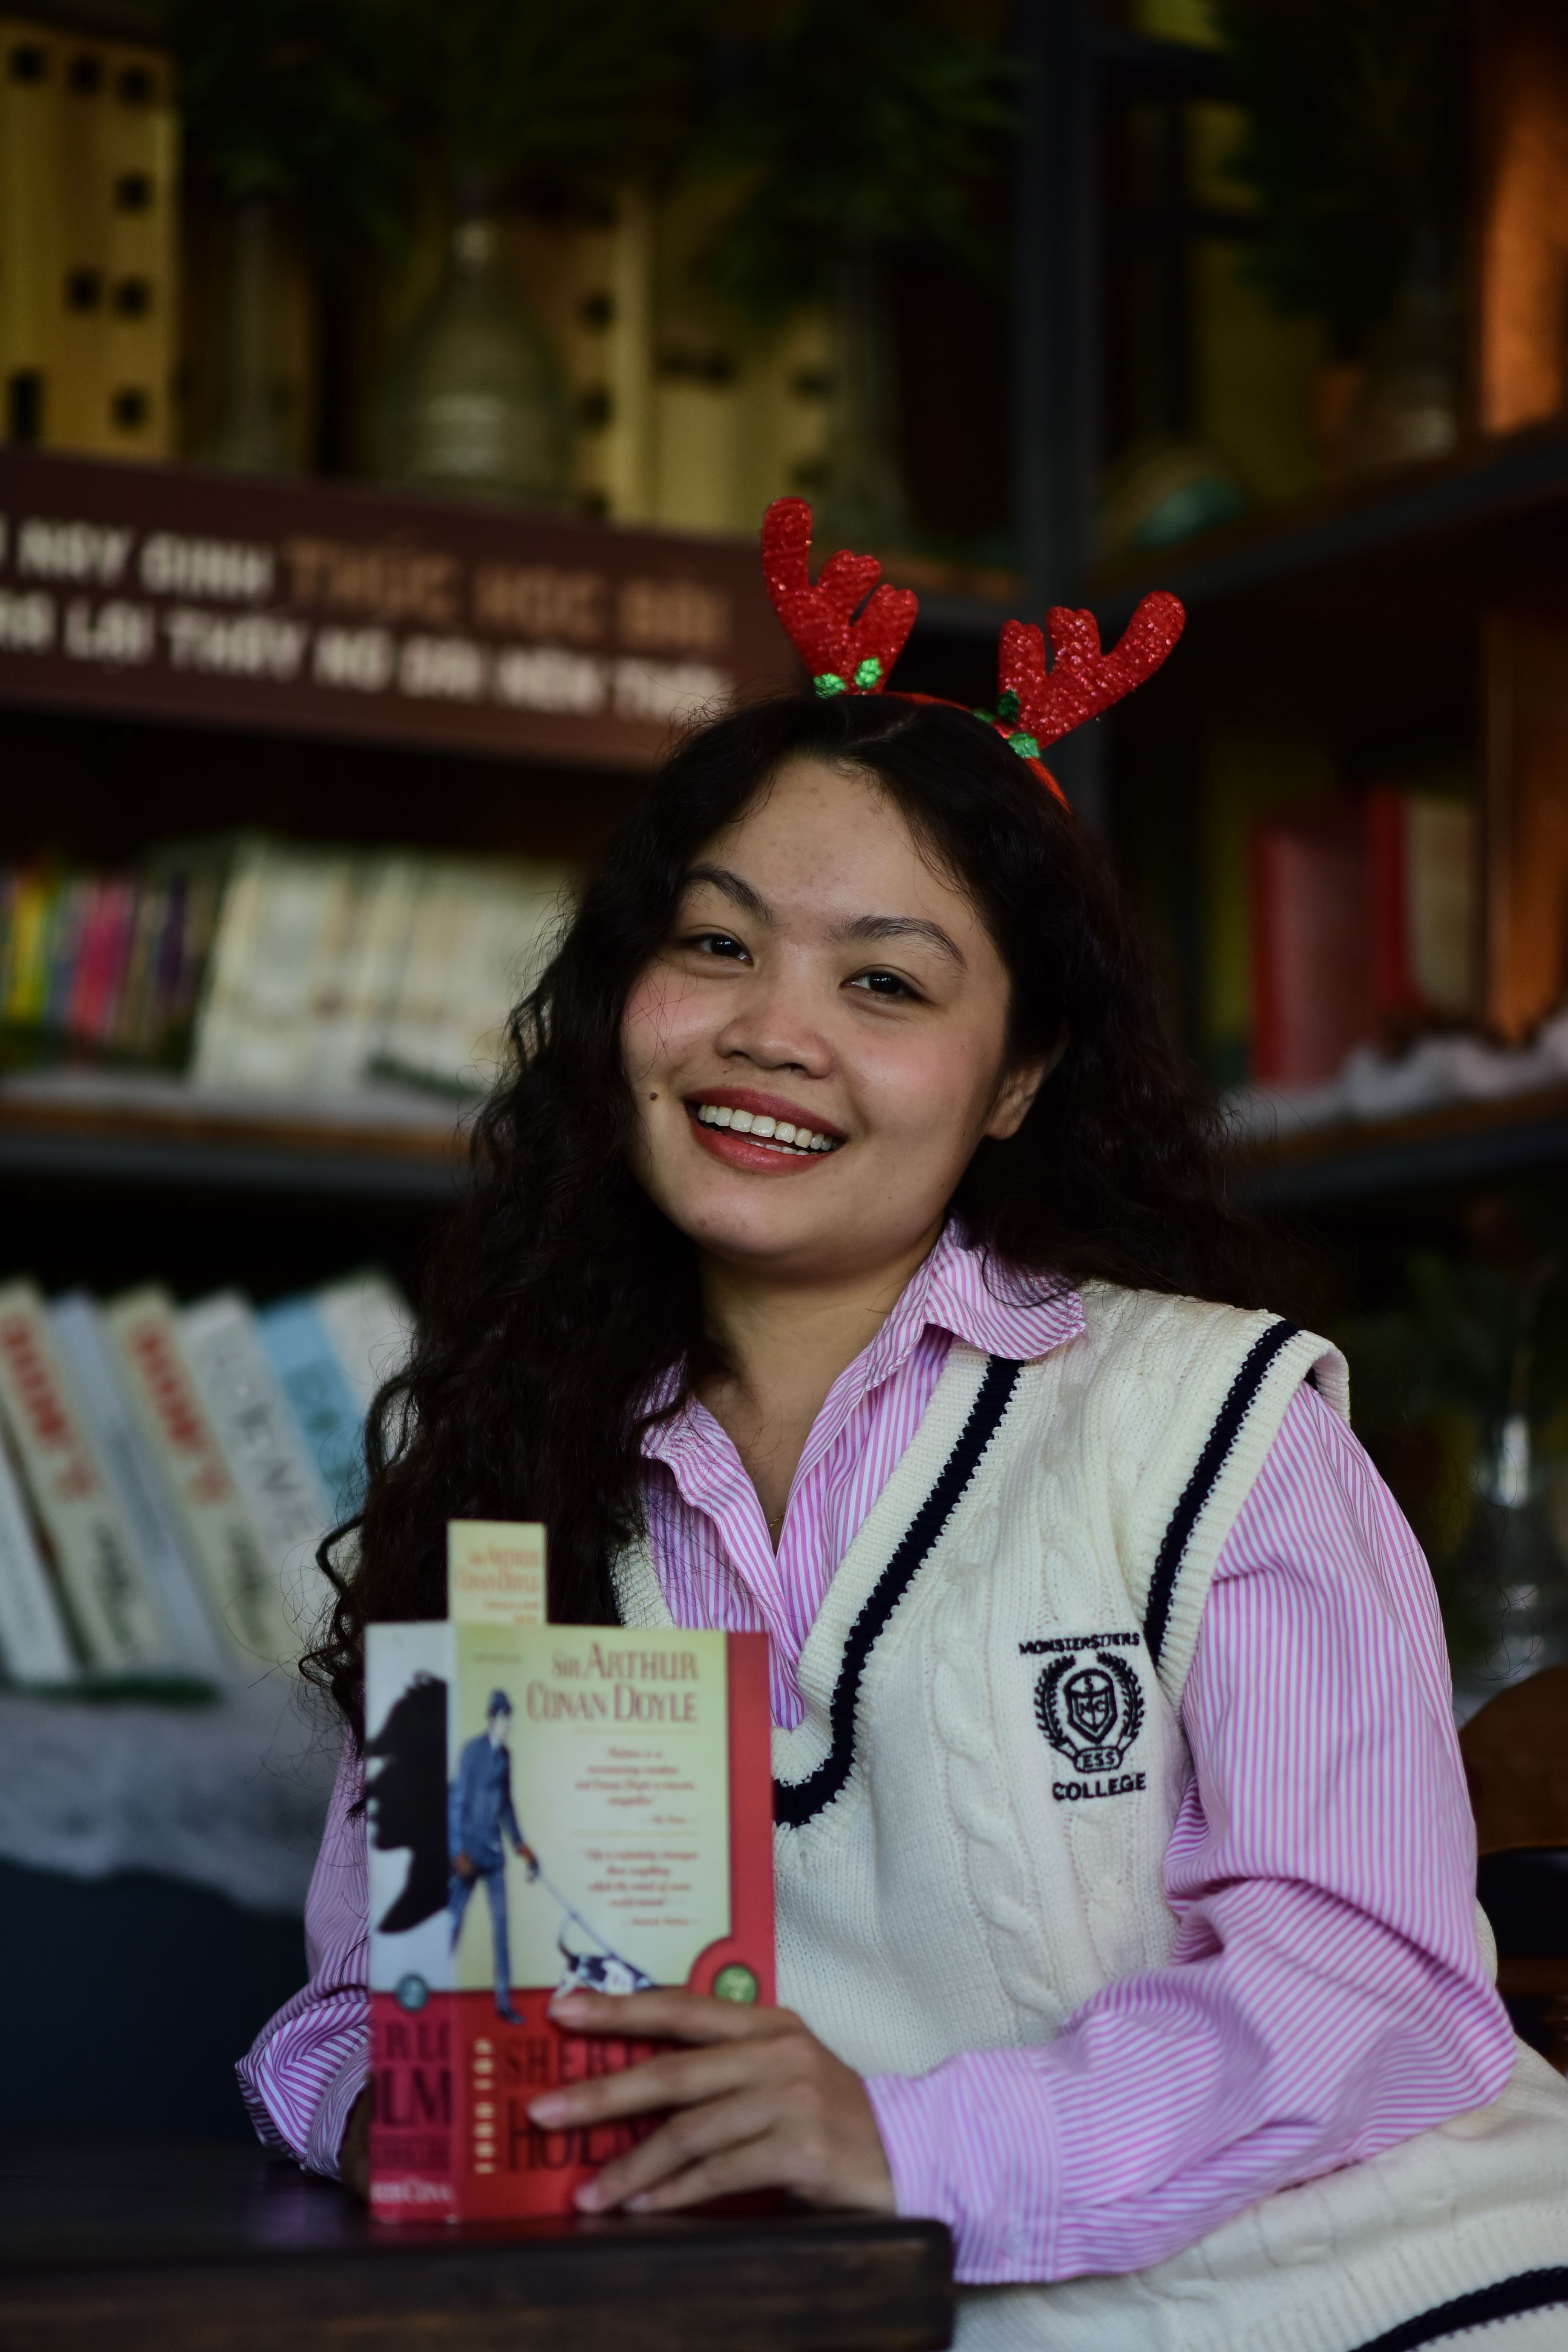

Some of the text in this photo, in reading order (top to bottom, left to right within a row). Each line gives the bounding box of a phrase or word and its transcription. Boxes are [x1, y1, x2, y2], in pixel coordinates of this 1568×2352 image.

[585, 1642, 698, 1681] ARTHUR
[526, 1680, 698, 1723] CONAN DOYLE
[1083, 1751, 1115, 1768] ESS
[1052, 1773, 1146, 1801] COLLEGE
